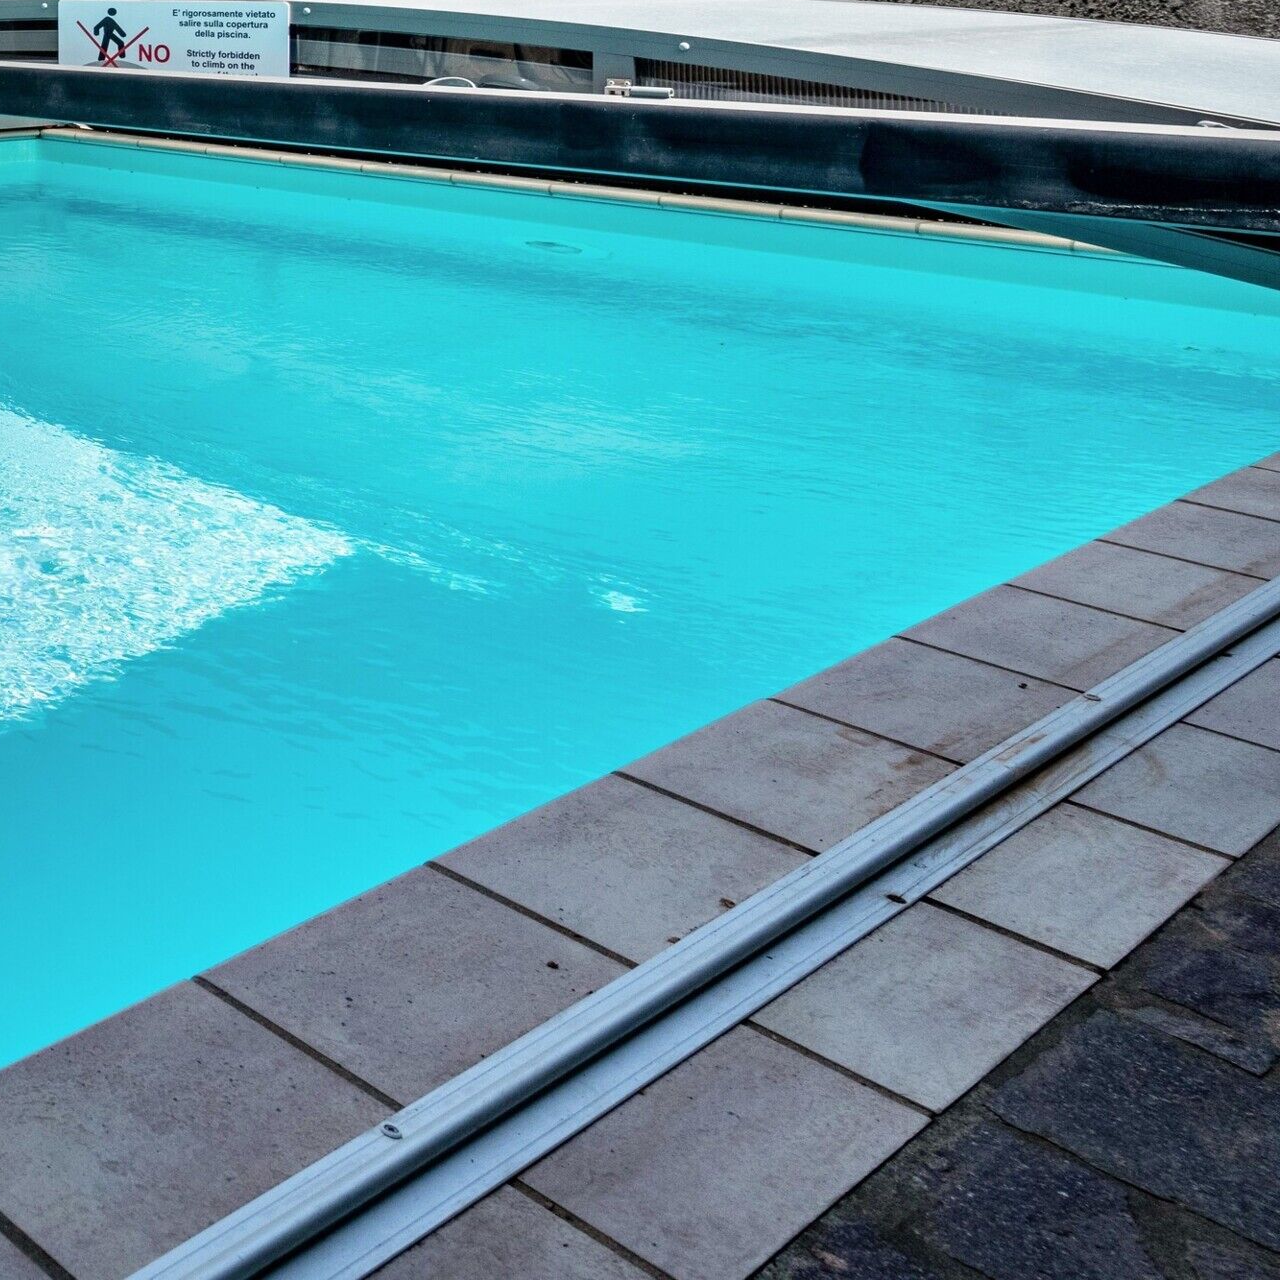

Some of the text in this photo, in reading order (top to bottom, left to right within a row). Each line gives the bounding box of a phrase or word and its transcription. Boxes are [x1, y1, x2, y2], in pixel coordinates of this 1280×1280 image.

[182, 9, 243, 19] rigorosamente
[245, 10, 276, 18] vietato
[203, 20, 224, 28] sulla
[226, 21, 269, 29] copertura
[195, 30, 251, 39] della piscina.
[139, 44, 171, 63] NO
[186, 49, 261, 60] Strictly forbidden
[191, 60, 200, 68] to
[202, 60, 226, 69] climb
[241, 62, 256, 70] the
